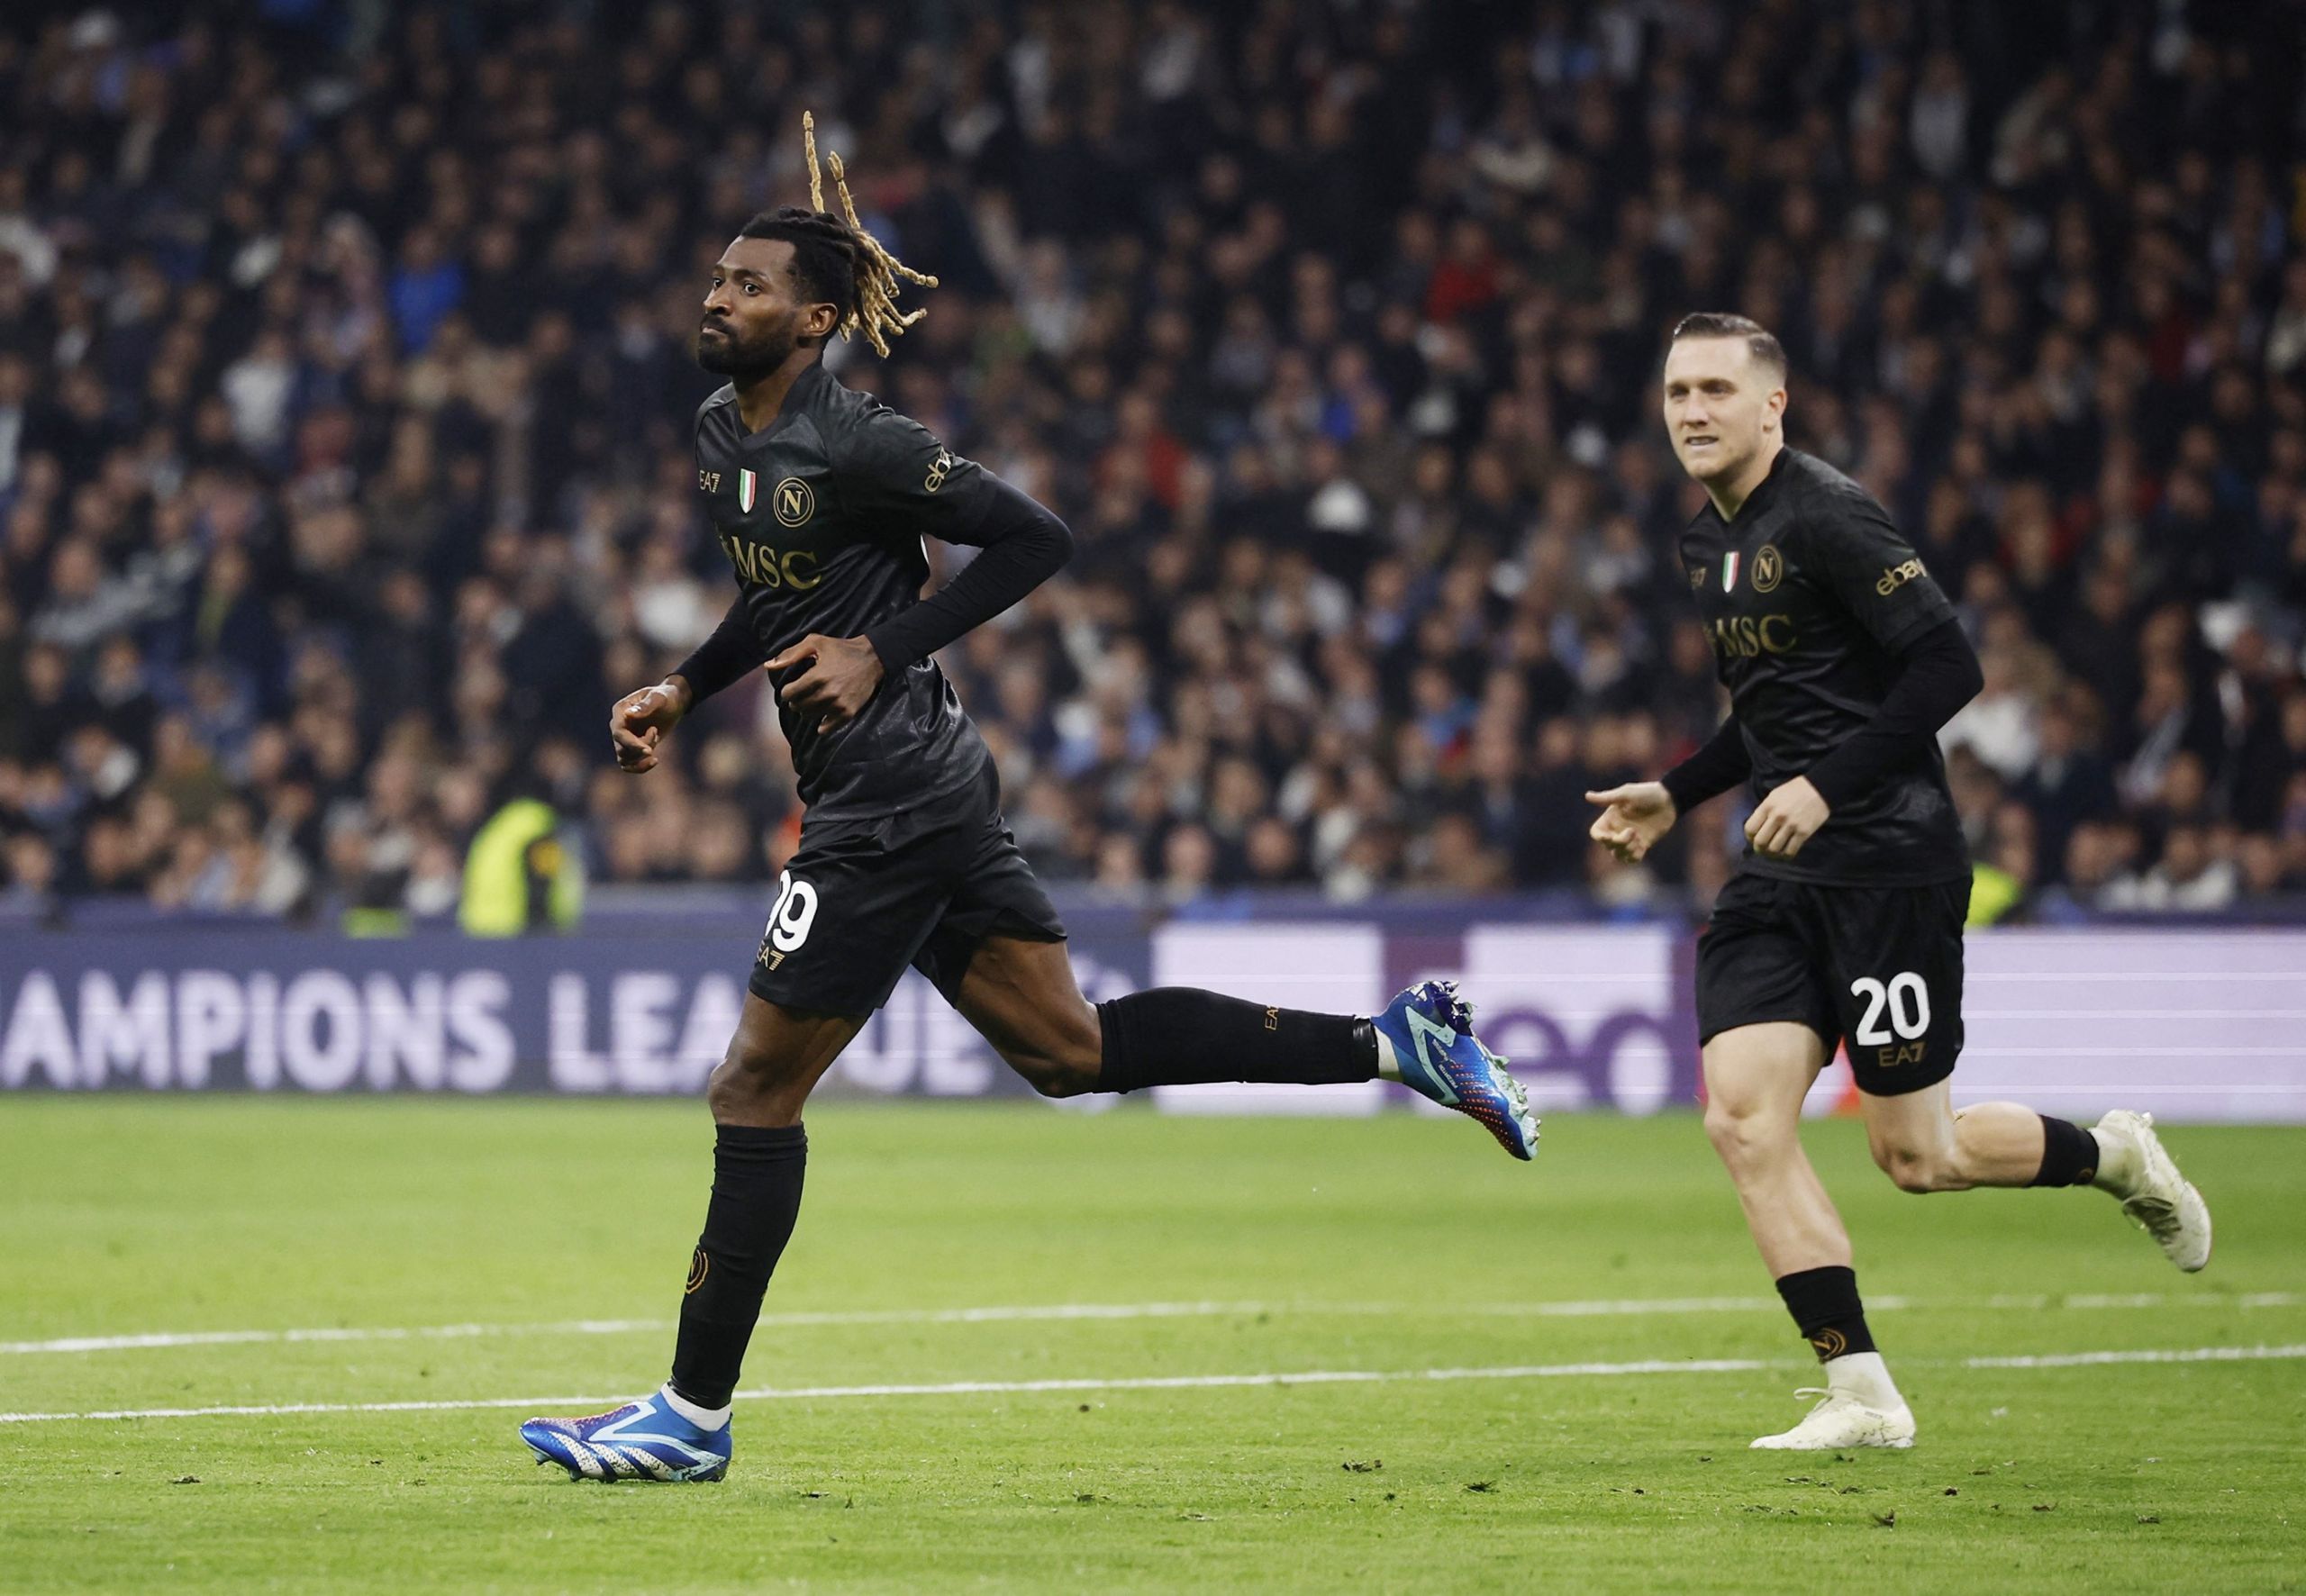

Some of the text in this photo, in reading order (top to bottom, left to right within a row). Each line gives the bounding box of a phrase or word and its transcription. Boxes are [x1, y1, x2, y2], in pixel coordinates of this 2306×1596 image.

[699, 469, 721, 494] EA7
[731, 536, 822, 590] MSC
[1716, 614, 1797, 657] MSC
[1265, 1006, 1279, 1030] EA
[1850, 971, 1930, 1046] 20
[1, 969, 991, 1094] AMPIONS LEAUE
[1878, 1041, 1926, 1067] EA7
